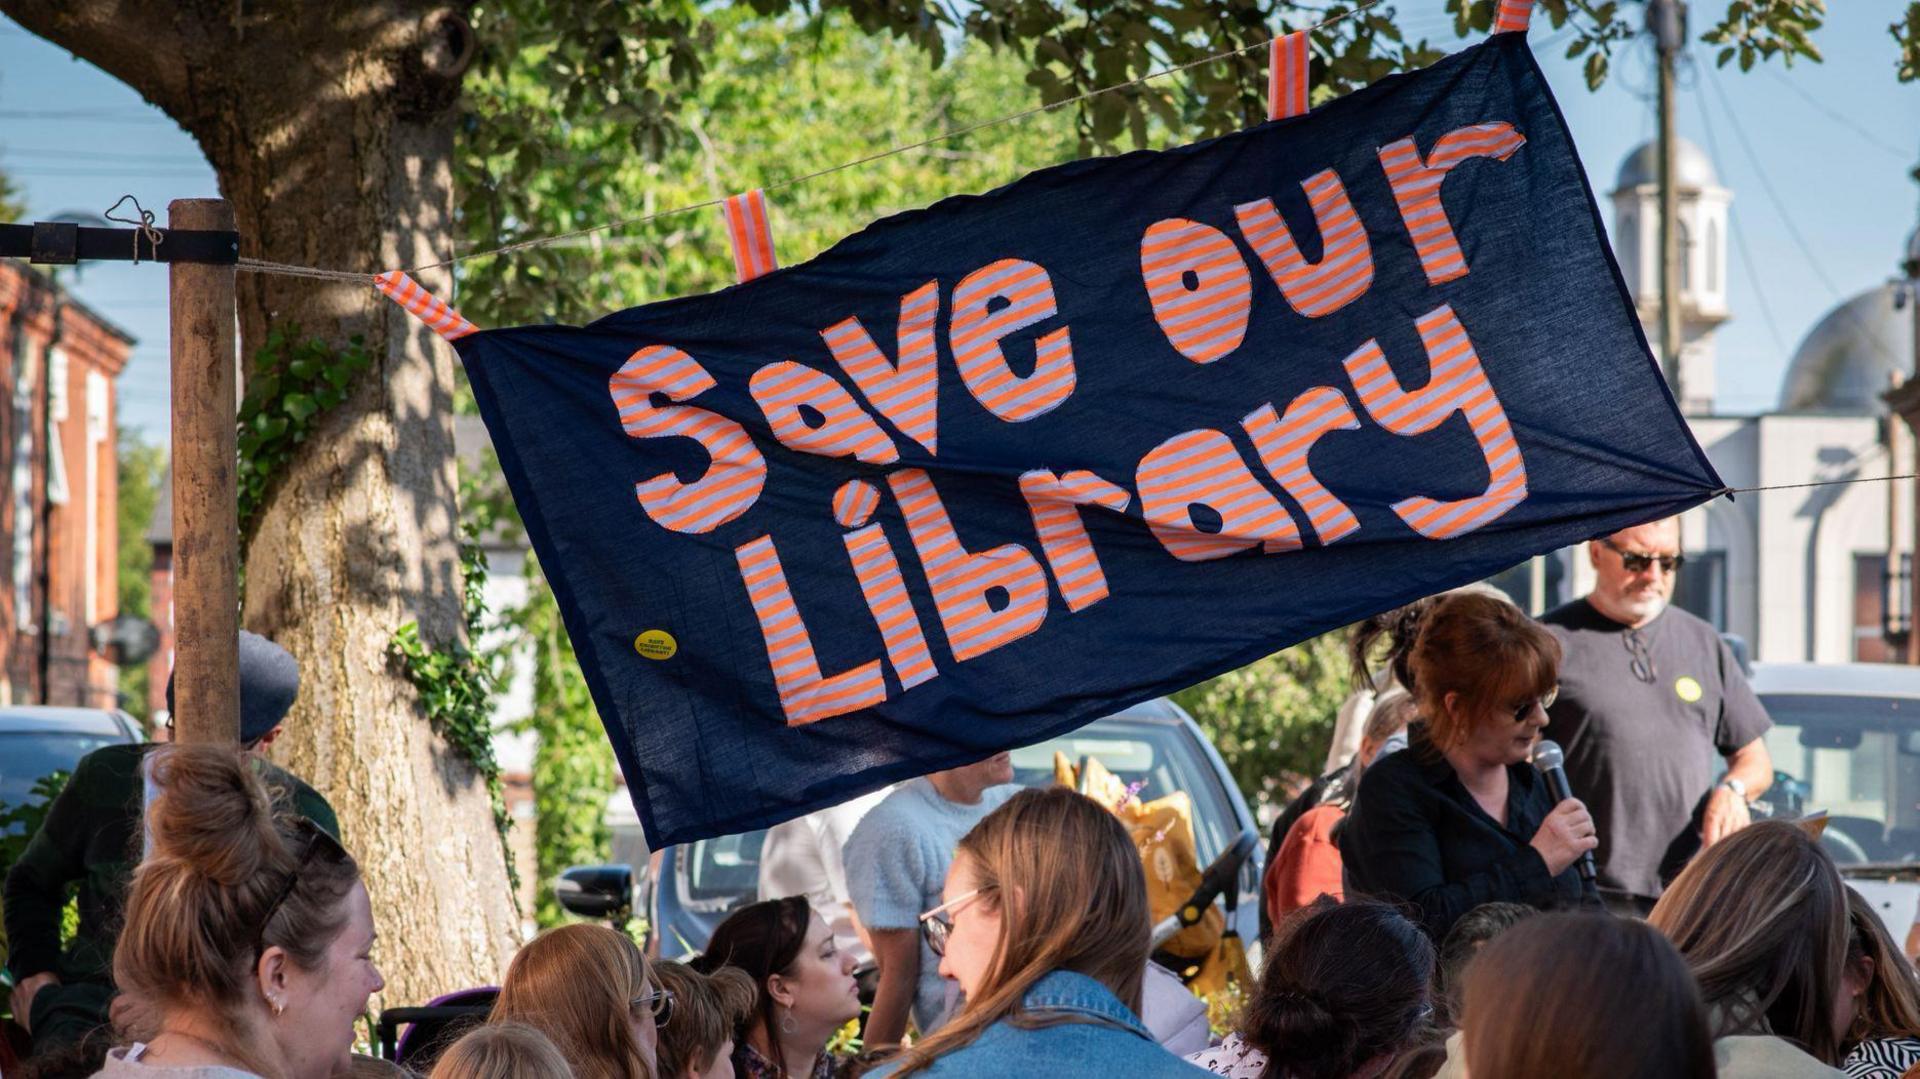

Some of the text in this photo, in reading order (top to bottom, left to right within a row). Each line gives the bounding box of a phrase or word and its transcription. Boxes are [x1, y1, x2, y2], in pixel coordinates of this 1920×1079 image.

[609, 121, 1527, 534] Save our
[735, 304, 1528, 727] Library
